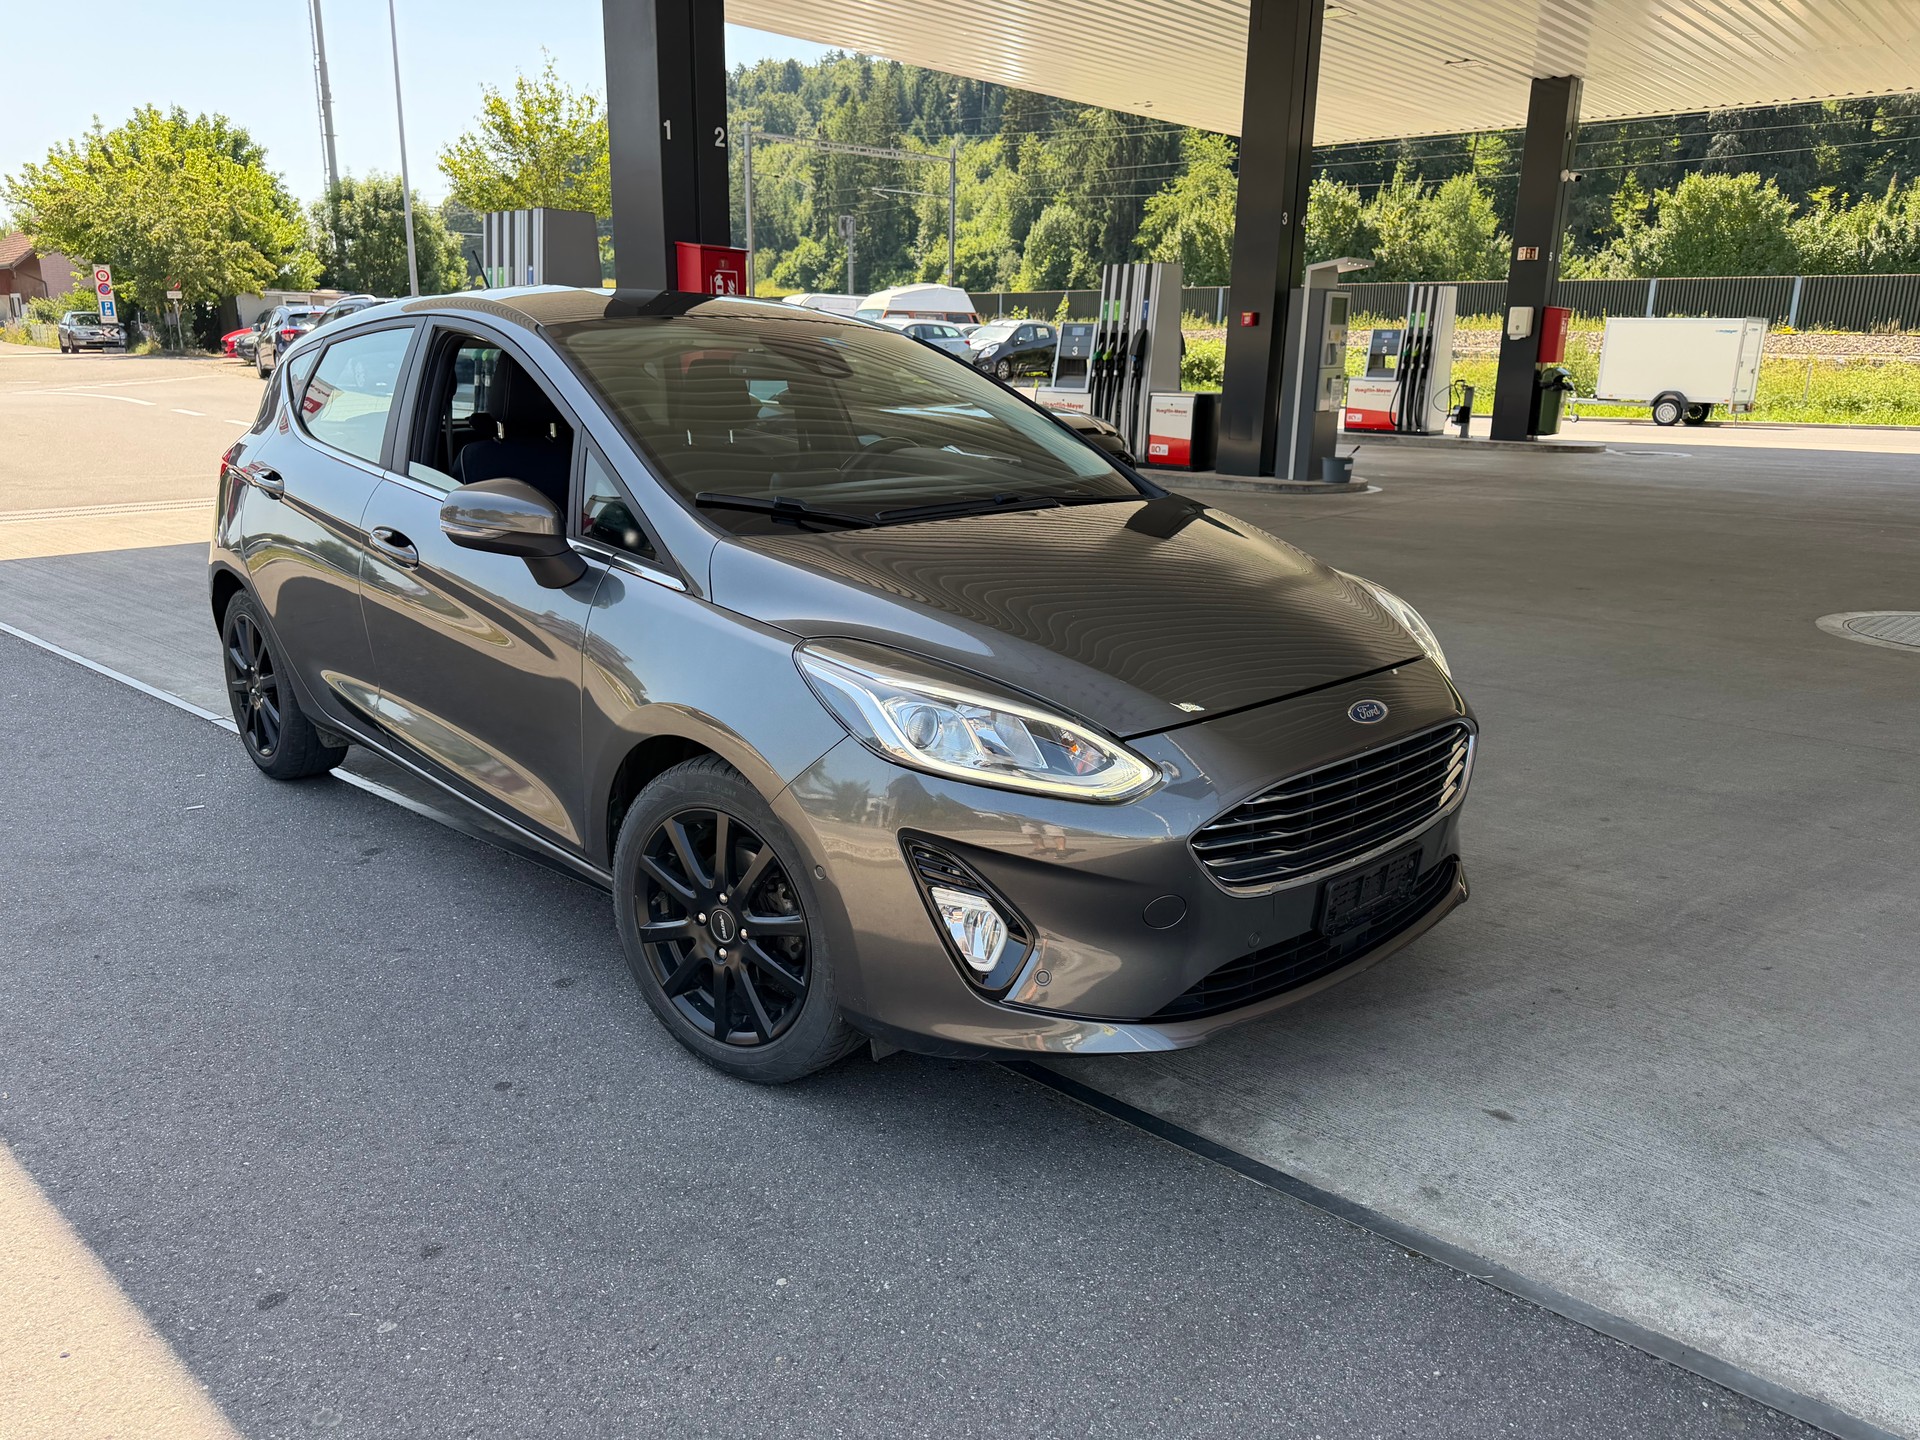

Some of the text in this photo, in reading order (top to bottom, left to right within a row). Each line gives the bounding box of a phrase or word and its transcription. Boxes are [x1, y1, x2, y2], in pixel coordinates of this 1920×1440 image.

[663, 119, 671, 140] 1
[714, 126, 726, 148] 2
[1282, 211, 1288, 226] 3
[1300, 215, 1306, 228] 4
[1072, 346, 1079, 356] 3
[1381, 346, 1388, 354] 5
[1356, 704, 1381, 720] Ford
